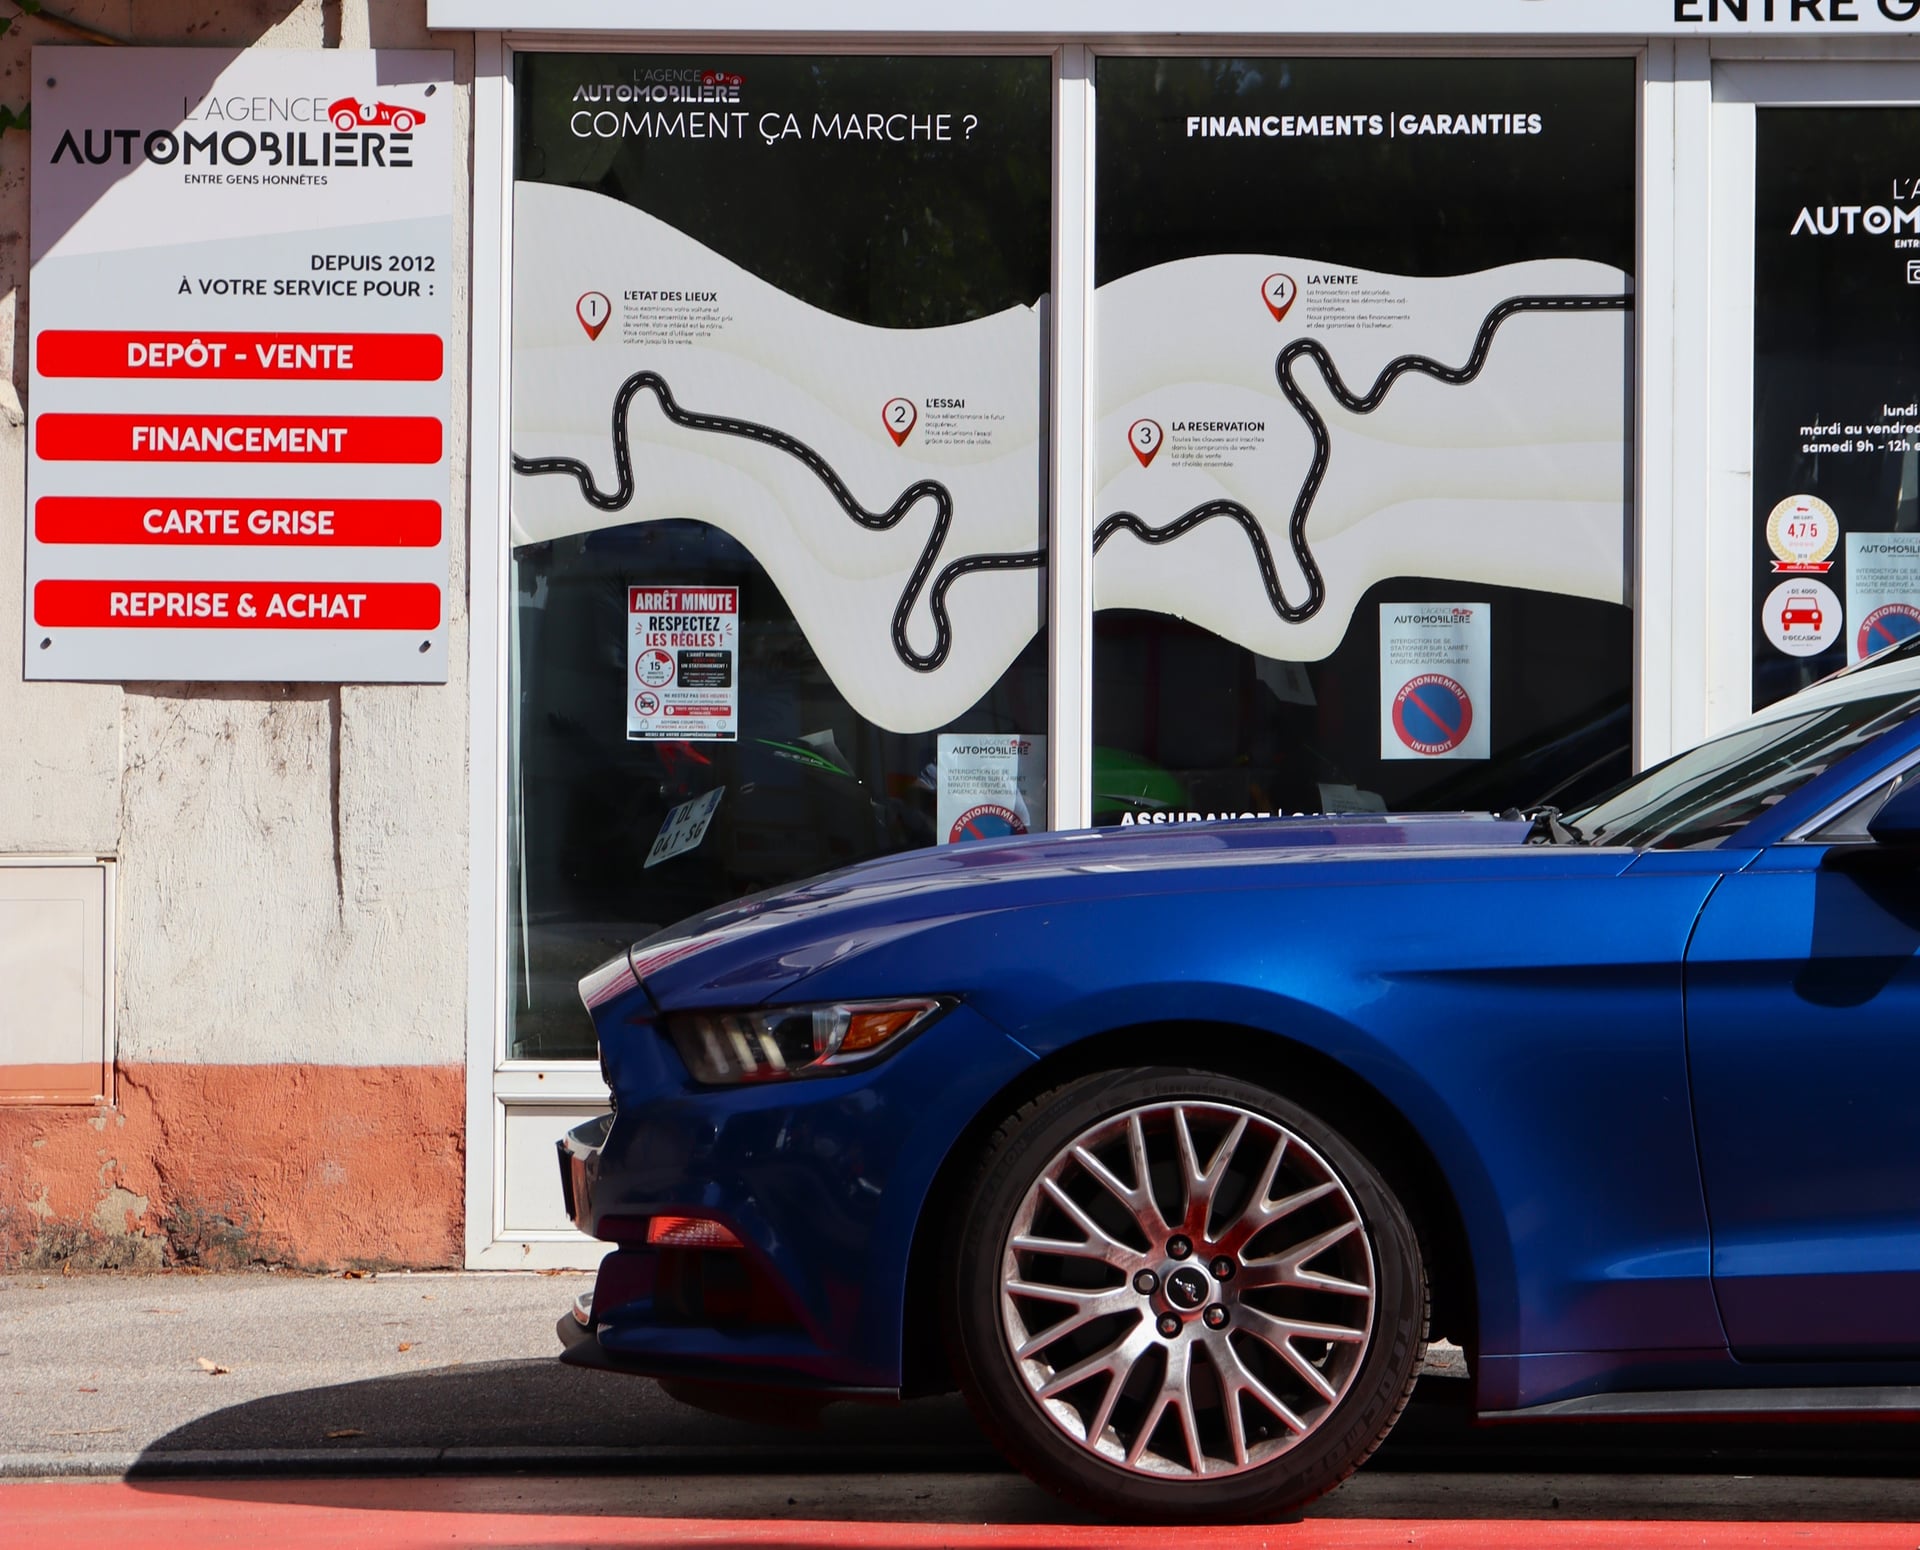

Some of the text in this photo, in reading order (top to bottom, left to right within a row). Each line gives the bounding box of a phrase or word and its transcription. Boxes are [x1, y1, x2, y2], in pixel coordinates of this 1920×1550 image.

[633, 69, 701, 82] L'AGENCE
[183, 96, 328, 121] L'AGENCE
[570, 111, 978, 145] COMMENT ÇA MARCHE ?
[1186, 113, 1543, 137] FINANCEMENTS GARANTIES
[184, 173, 328, 186] ENTRE GENS HONNÊTES
[311, 255, 435, 272] DEPUIS 2012
[178, 276, 192, 295] À
[199, 280, 267, 296] VOTRE
[273, 280, 357, 297] SERVICE
[363, 281, 420, 297] POUR
[1307, 275, 1358, 284] LA VENTE
[624, 290, 717, 301] L'ETAT DES LIEUX
[1273, 282, 1286, 299] 4
[589, 300, 597, 317] 1
[127, 339, 227, 368] DEPÔT
[255, 344, 354, 369] VENTE
[926, 398, 965, 408] L'ESSAI
[1883, 404, 1918, 416] lundi
[893, 406, 906, 424] 2
[1172, 422, 1265, 431] LA RESERVATION
[1800, 422, 1841, 436] mardi
[1844, 425, 1863, 435] au
[132, 426, 347, 453] FINANCEMENT
[1140, 427, 1153, 445] 3
[1802, 440, 1853, 453] samedi
[1856, 440, 1874, 452] 9h
[1888, 439, 1910, 452] 12h
[143, 509, 335, 536] CARTE GRISE
[110, 592, 367, 619] REPRISE & ACHAT
[635, 590, 732, 611] ARRÊT MINUTE
[649, 616, 720, 631] RESPECTEZ
[646, 633, 667, 646] LES
[650, 662, 661, 671] 15
[1398, 675, 1467, 702] STATIONNEMENT
[1411, 740, 1453, 753] INTERDIT
